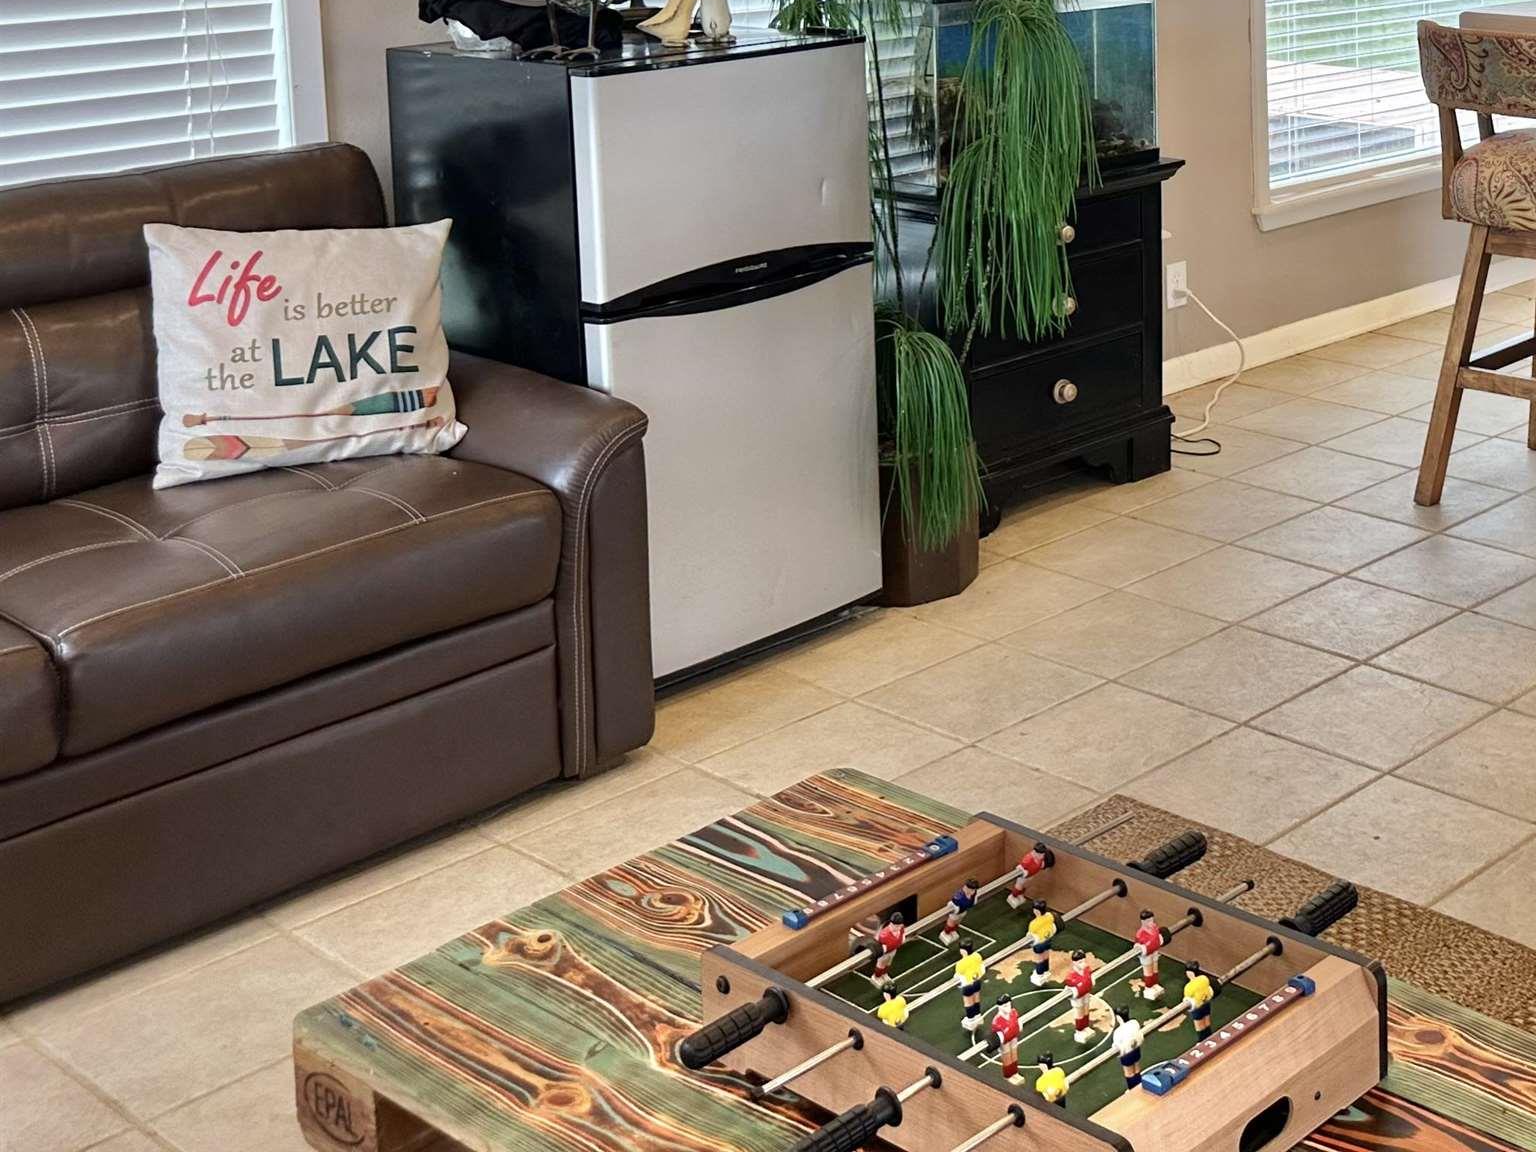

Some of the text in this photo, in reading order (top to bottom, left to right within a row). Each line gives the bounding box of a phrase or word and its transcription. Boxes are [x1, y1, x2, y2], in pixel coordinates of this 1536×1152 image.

[187, 250, 283, 327] Life
[283, 292, 397, 321] is better
[204, 363, 256, 392] the
[229, 326, 420, 387] at LAKE
[1178, 986, 1297, 1066] 1 2 3 4 5 6 7 8 9
